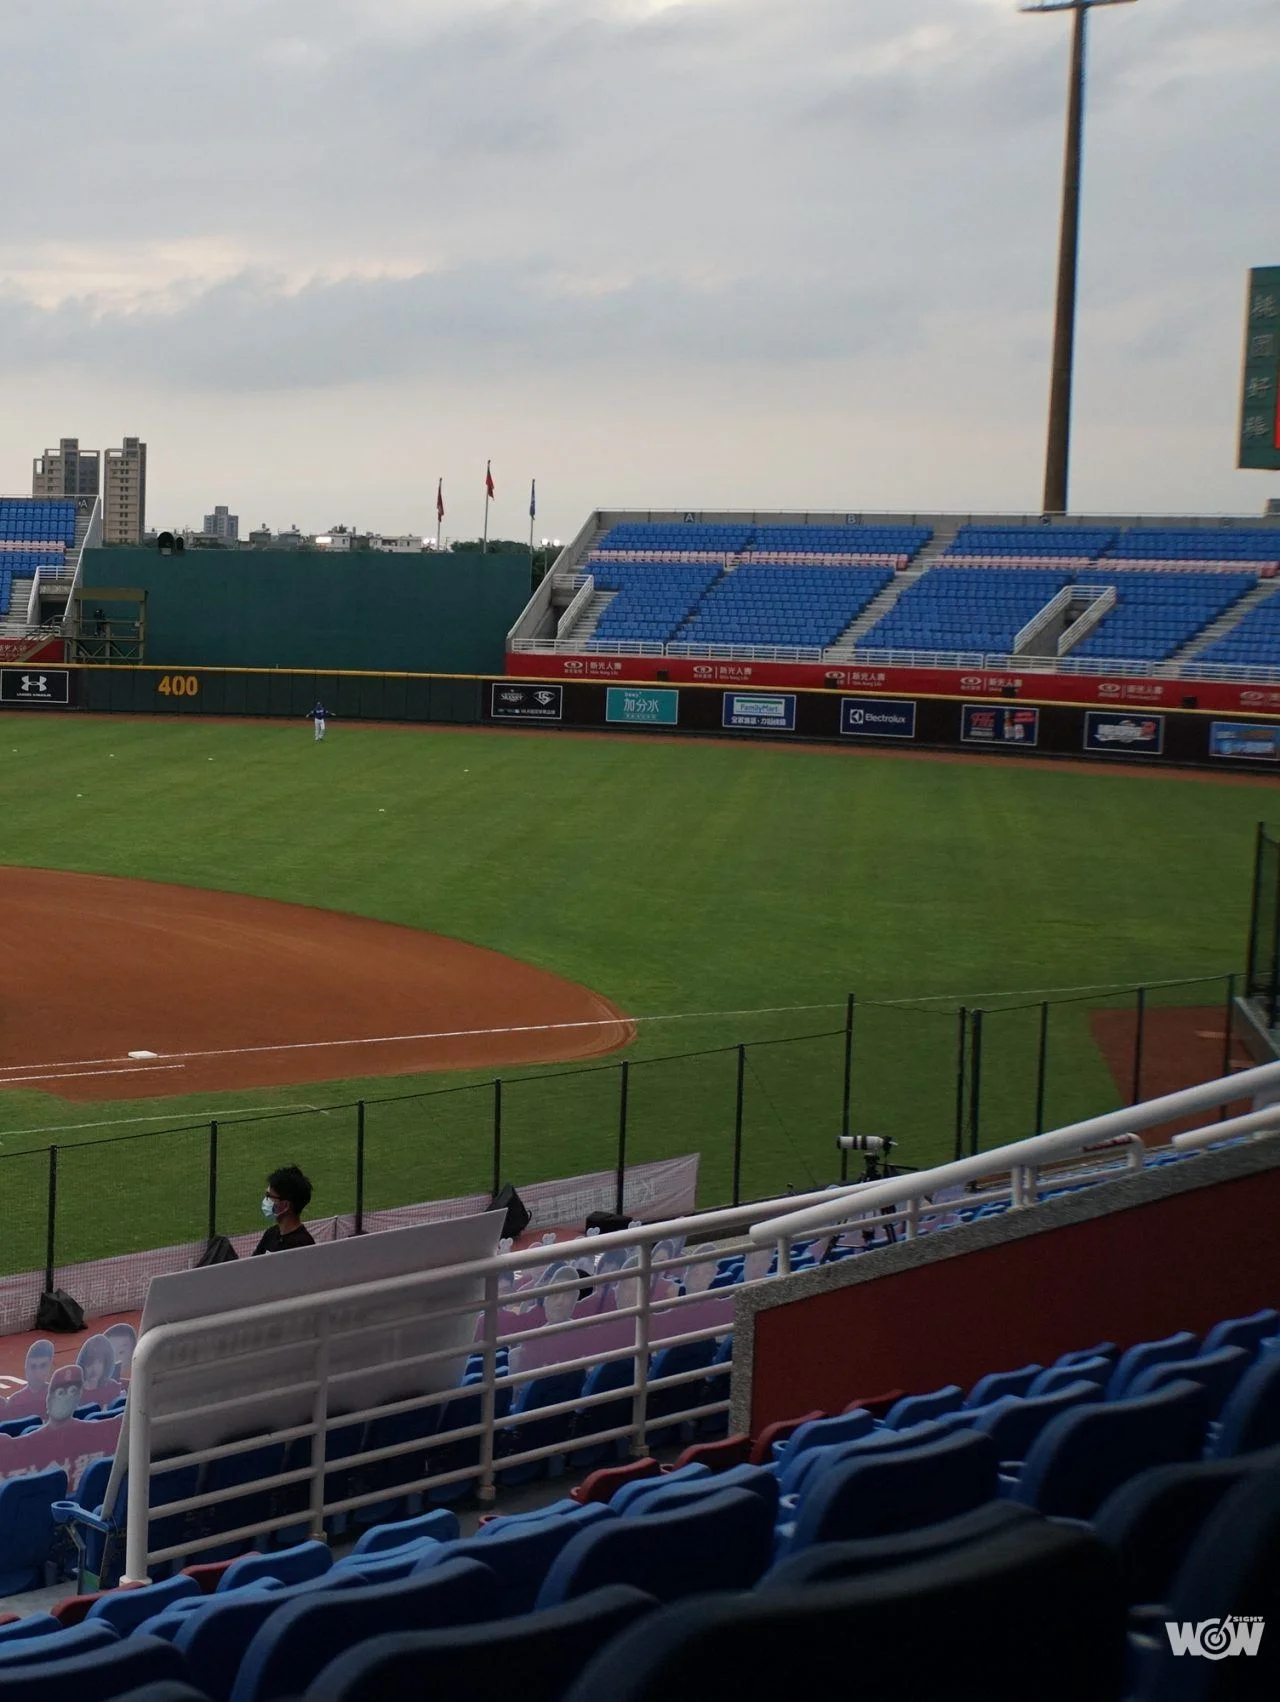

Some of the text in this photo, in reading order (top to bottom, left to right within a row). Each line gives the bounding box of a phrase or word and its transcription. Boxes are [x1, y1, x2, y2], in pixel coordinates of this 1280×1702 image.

[684, 512, 696, 523] A
[846, 514, 857, 524] B
[158, 675, 198, 696] 400
[623, 698, 659, 713] 加分水
[740, 704, 778, 713] FamilyMart
[865, 713, 906, 724] Electrolux
